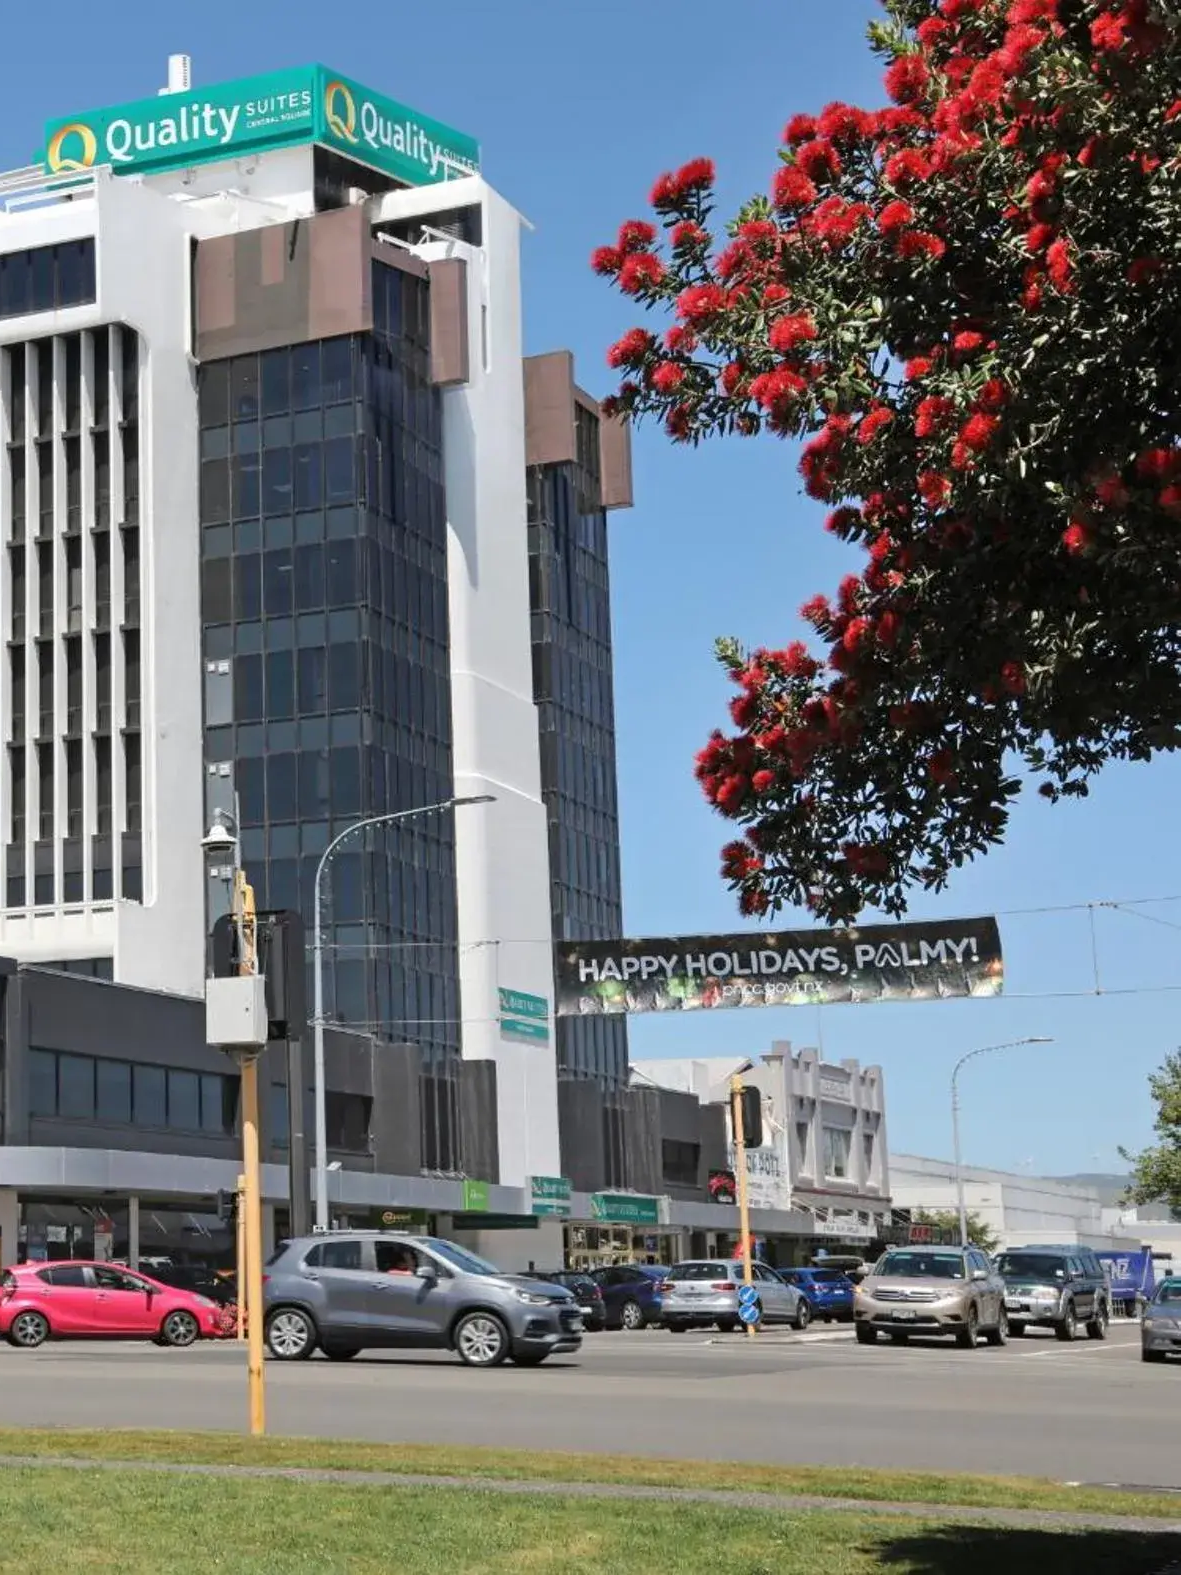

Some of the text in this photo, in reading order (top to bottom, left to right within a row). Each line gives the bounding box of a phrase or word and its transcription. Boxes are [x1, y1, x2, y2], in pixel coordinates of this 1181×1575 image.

[105, 104, 240, 161] Quality
[246, 91, 311, 117] SUITES
[361, 101, 441, 176] Quality
[578, 954, 679, 982] HAPPY
[686, 946, 849, 977] HOLIDAYS,
